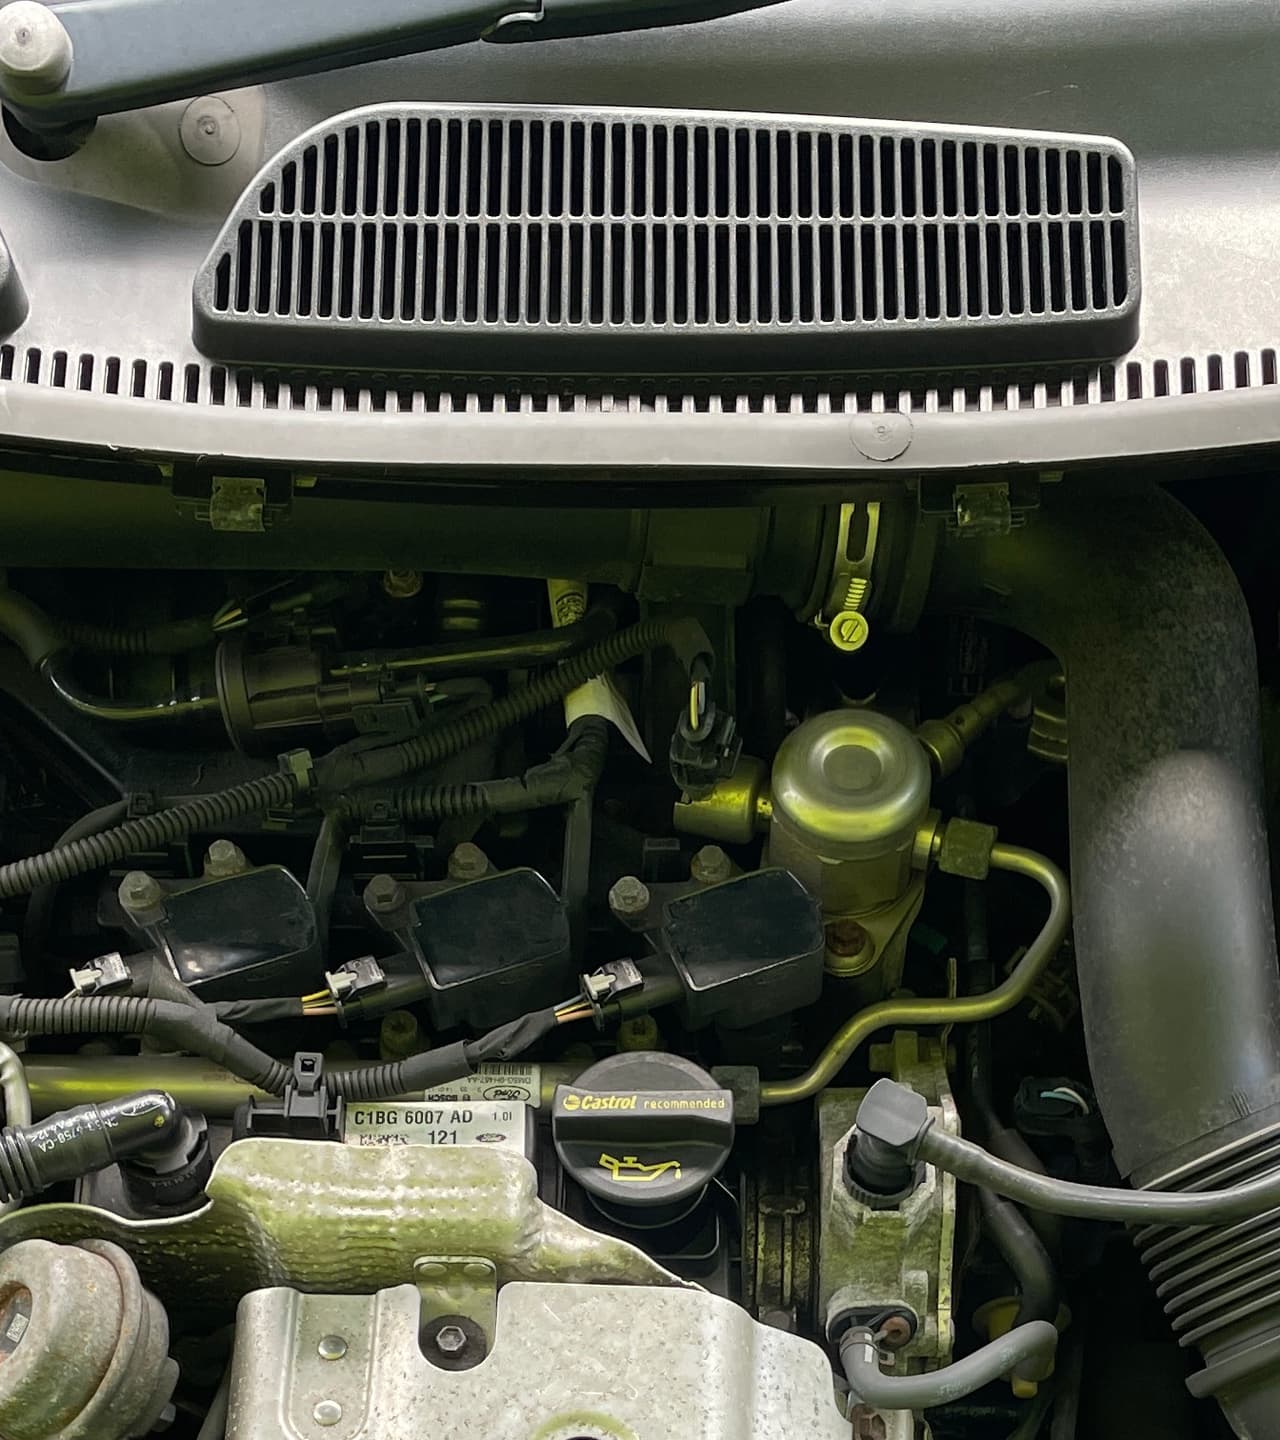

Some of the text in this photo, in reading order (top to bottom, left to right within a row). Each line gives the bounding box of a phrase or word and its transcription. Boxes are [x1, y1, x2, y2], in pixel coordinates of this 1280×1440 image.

[581, 1095, 725, 1110] Castrol recommended
[355, 1110, 398, 1125] C1BG
[404, 1110, 444, 1125] 6007
[450, 1110, 473, 1124] AD
[427, 1130, 458, 1145] 121
